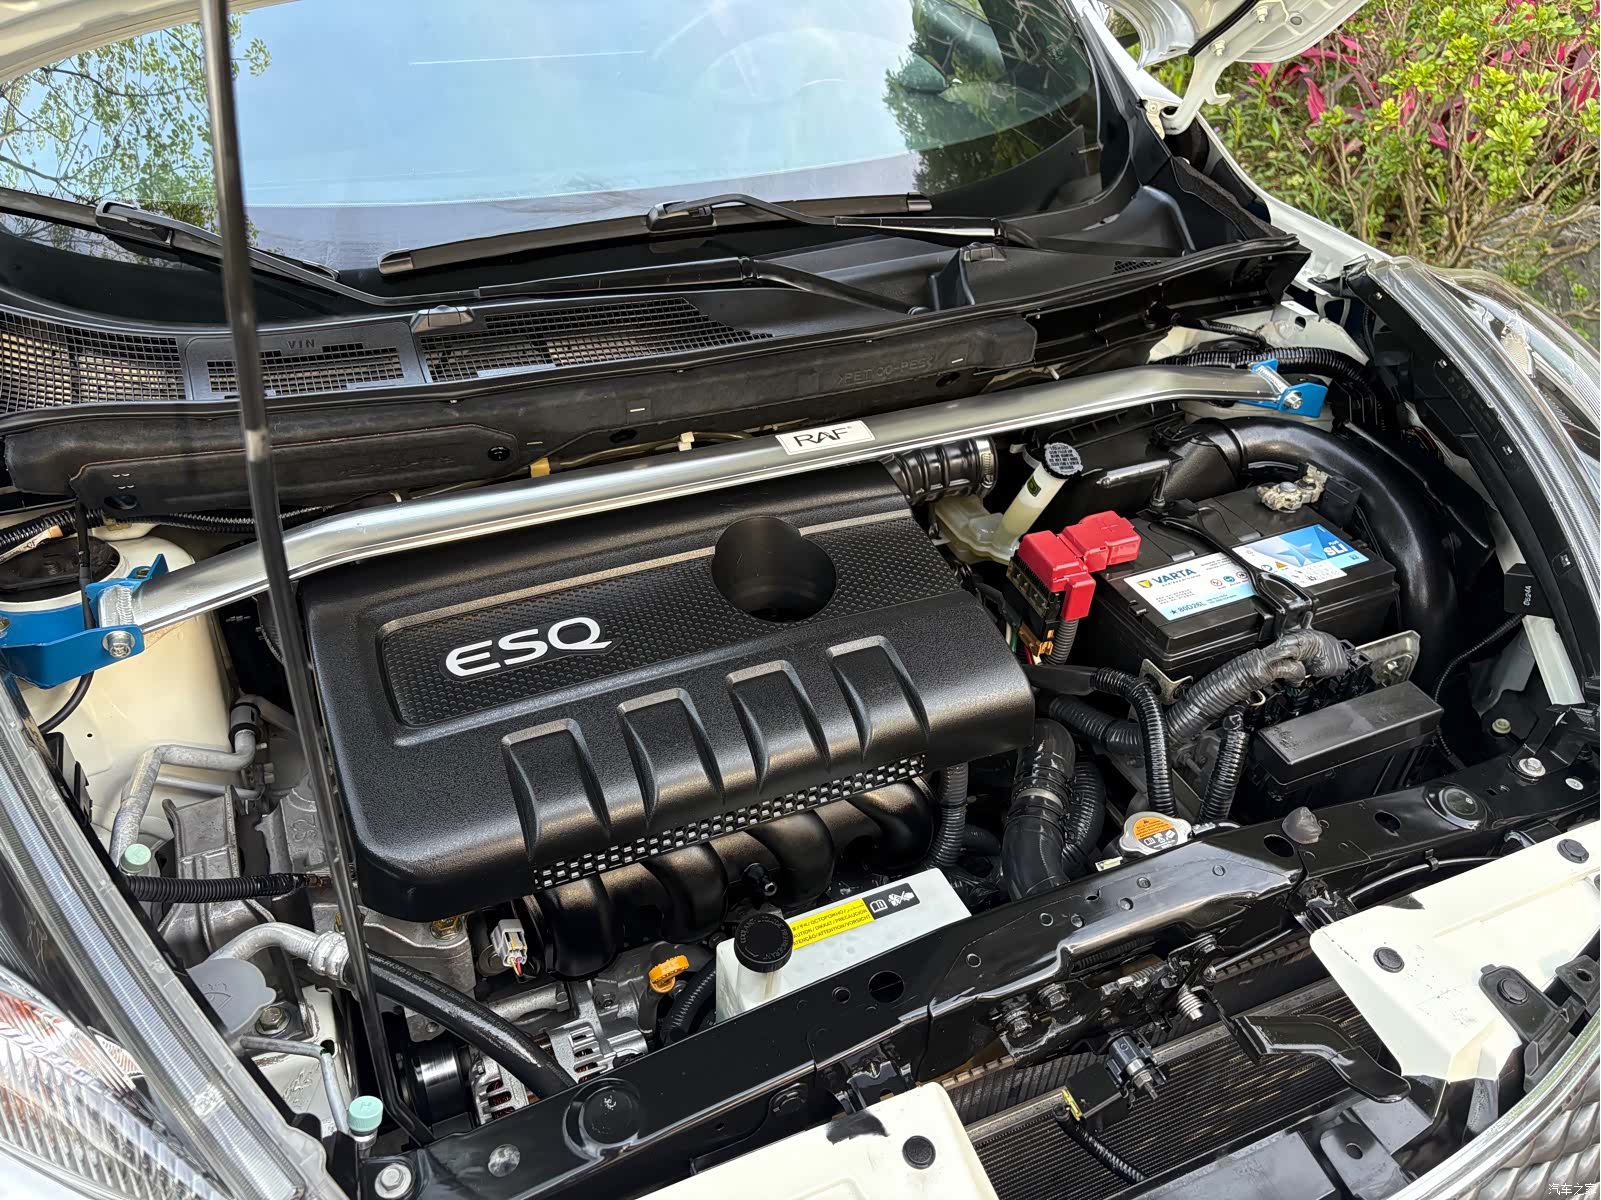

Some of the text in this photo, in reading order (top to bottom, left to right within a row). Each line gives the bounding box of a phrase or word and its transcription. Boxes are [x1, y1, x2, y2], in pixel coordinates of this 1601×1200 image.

[288, 339, 315, 349] VIN
[793, 426, 849, 447] RAF
[1323, 543, 1349, 557] SLI
[1152, 568, 1197, 584] VARTA
[445, 617, 613, 677] ESQ
[793, 928, 812, 938] AUTION
